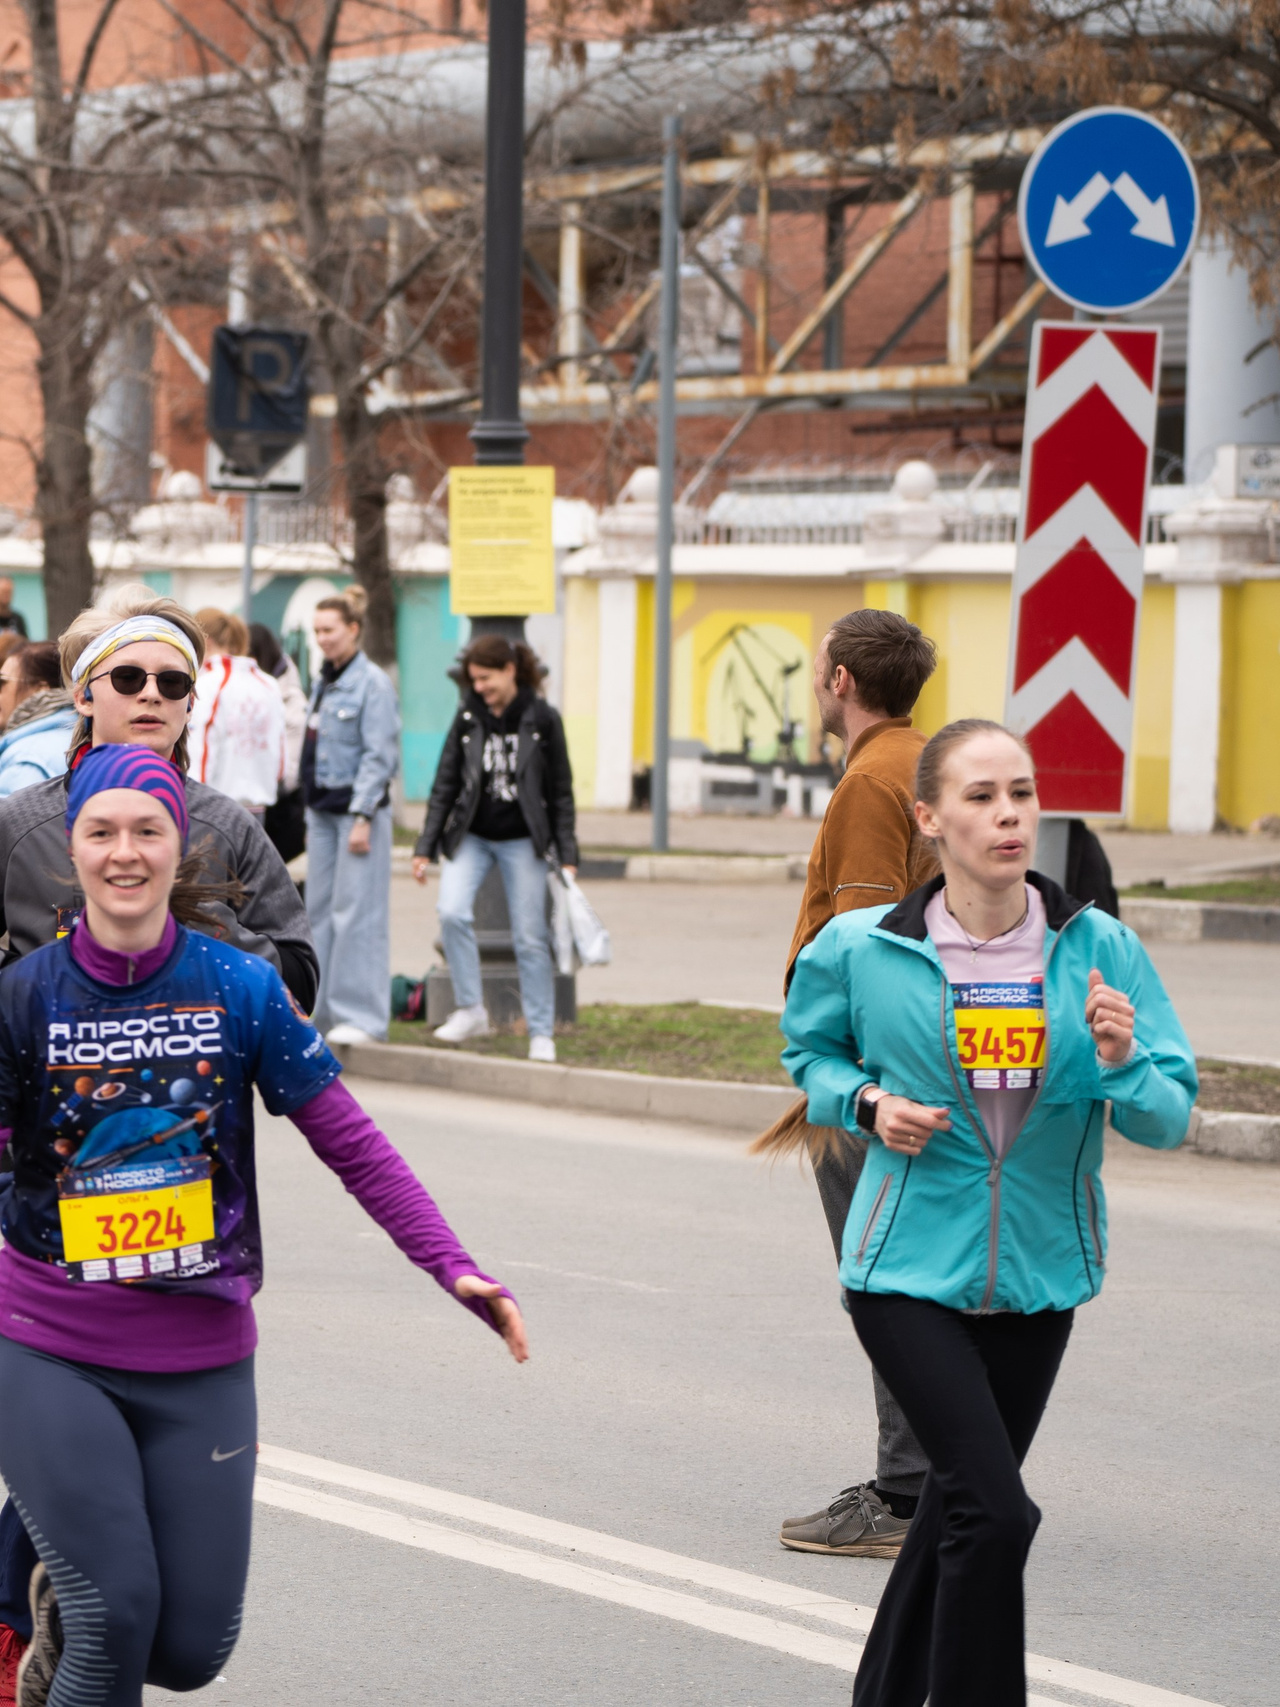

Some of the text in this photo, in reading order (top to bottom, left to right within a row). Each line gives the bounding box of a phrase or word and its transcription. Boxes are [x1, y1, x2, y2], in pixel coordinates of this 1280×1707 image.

[48, 1011, 220, 1041] Я ПРОСТО
[958, 1026, 1046, 1064] 3457
[113, 1167, 166, 1181] ПРОСТО
[117, 1193, 150, 1205] ОЛЬГА
[96, 1206, 186, 1253] 3224
